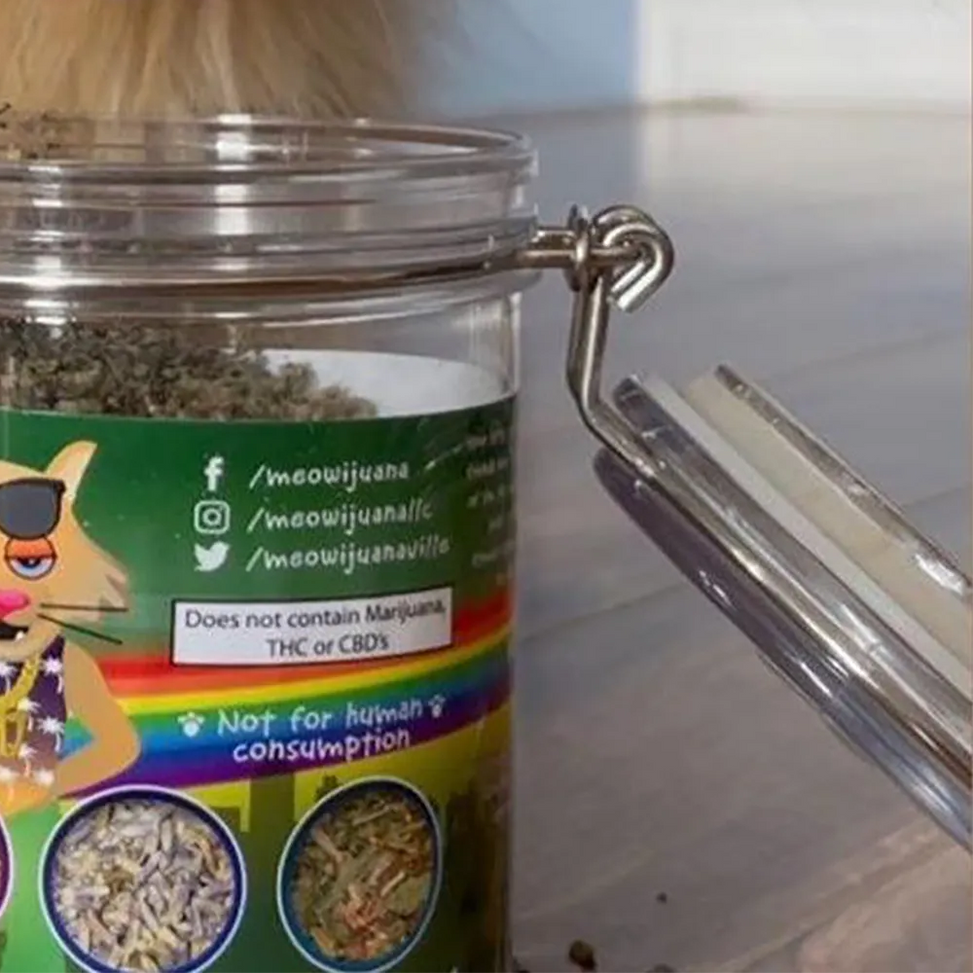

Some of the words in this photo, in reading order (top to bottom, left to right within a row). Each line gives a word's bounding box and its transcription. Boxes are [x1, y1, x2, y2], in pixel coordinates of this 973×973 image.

[184, 609, 240, 629] Does
[245, 610, 282, 628] not
[286, 608, 361, 628] contain
[265, 638, 309, 658] THC
[313, 637, 334, 655] or
[217, 710, 277, 737] Not
[290, 706, 336, 734] for
[345, 698, 424, 727] human
[232, 727, 412, 764] consumption
